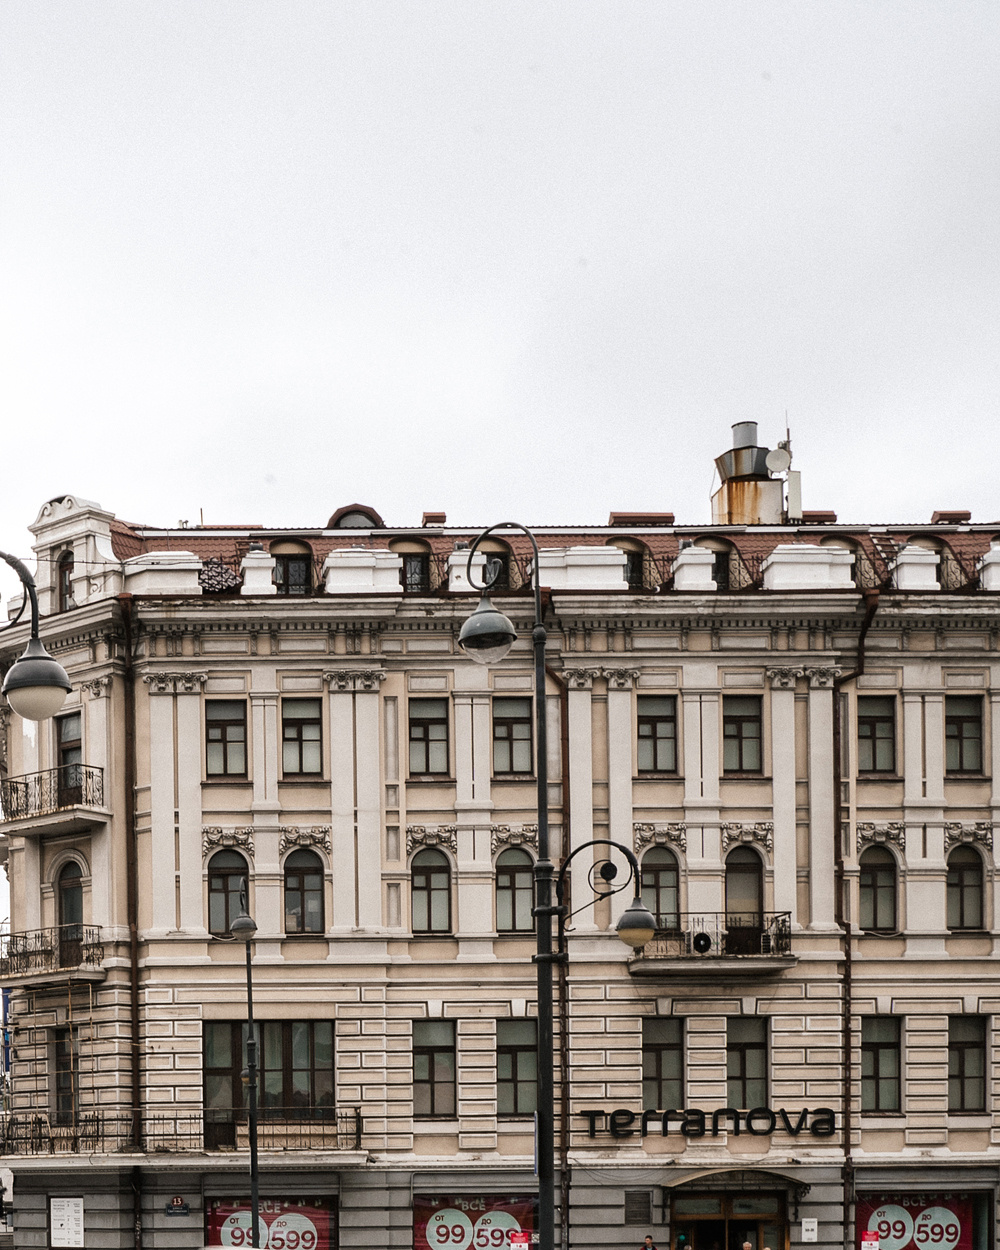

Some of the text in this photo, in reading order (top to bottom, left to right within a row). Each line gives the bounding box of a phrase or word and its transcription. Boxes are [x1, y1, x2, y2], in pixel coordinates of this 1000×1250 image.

[461, 1201, 486, 1211] ВСЕ
[903, 1198, 926, 1207] ВСЕ
[271, 1230, 316, 1250] 599
[435, 1224, 466, 1244] 99
[877, 1220, 906, 1240] 99
[916, 1223, 959, 1243] 599
